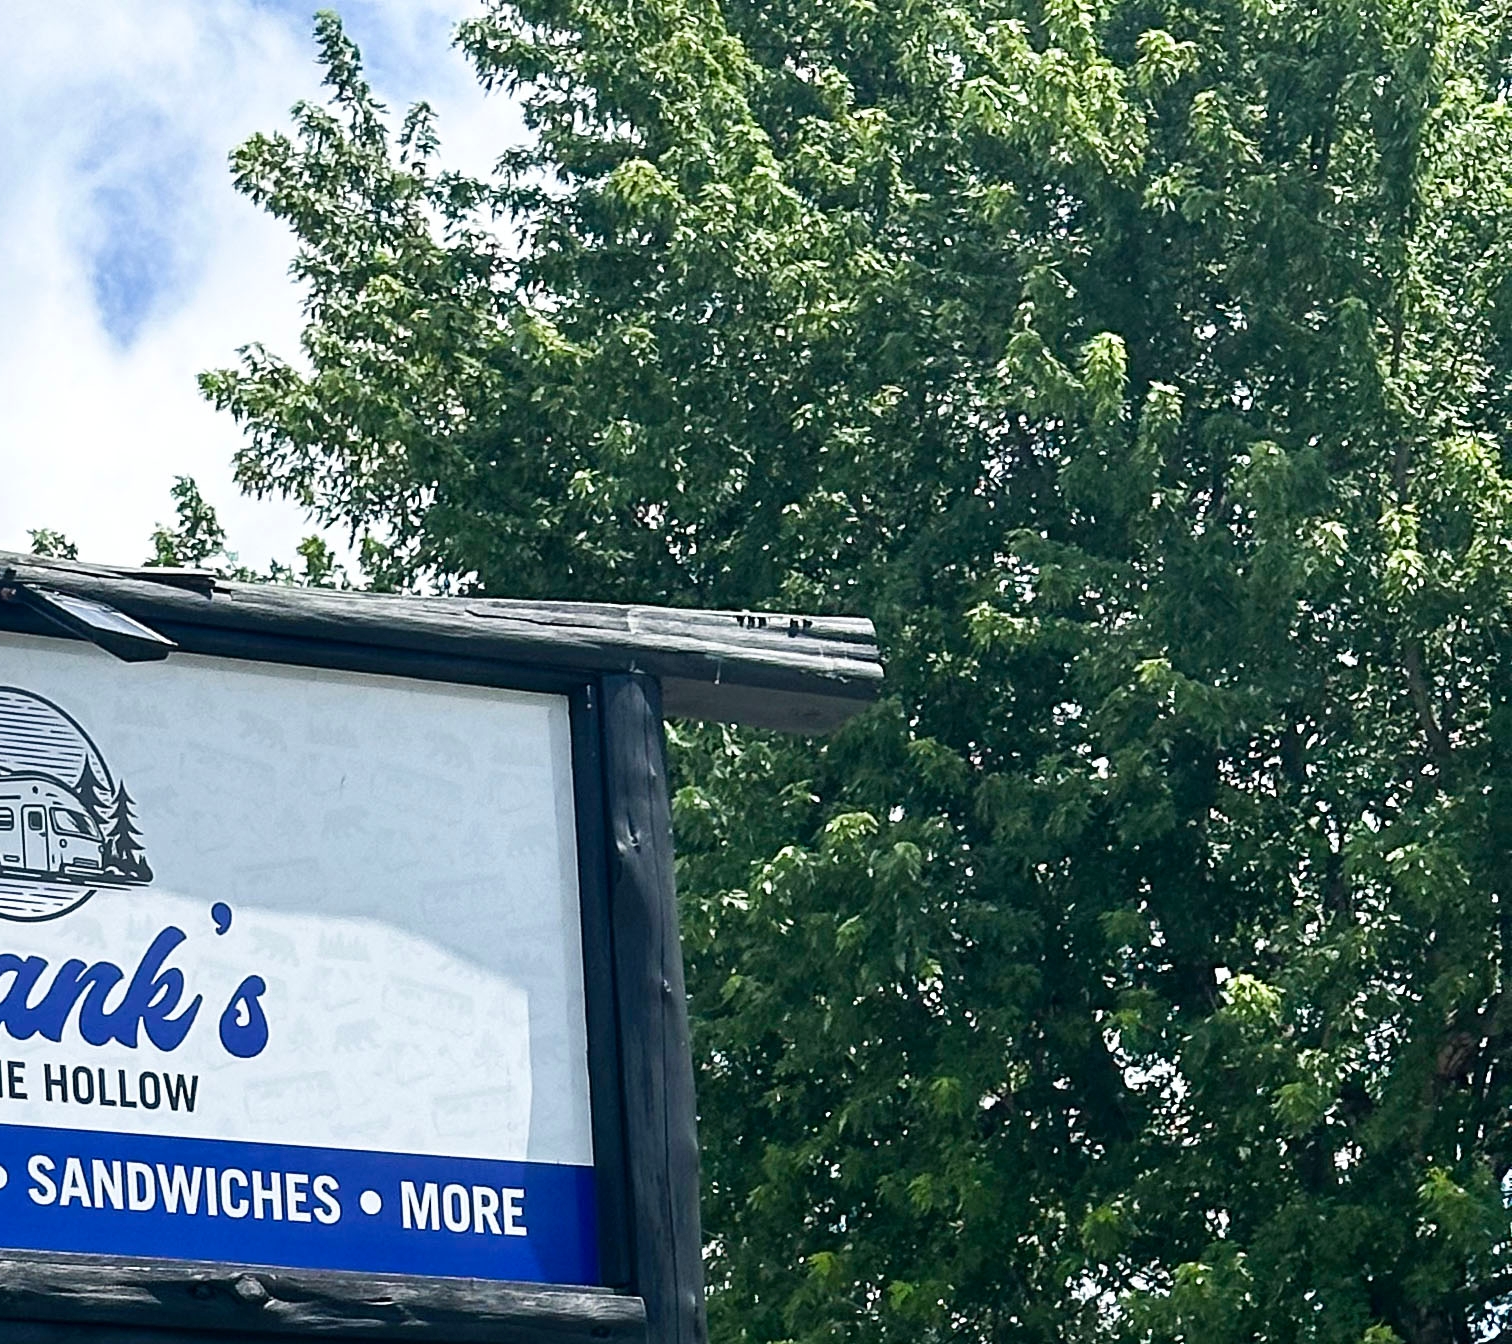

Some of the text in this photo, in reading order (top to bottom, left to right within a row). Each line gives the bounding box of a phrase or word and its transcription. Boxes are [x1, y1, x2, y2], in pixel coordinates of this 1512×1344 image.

[43, 1063, 199, 1113] HOLLOW
[27, 1154, 341, 1224] SANDWICHES
[400, 1181, 527, 1236] MORE
